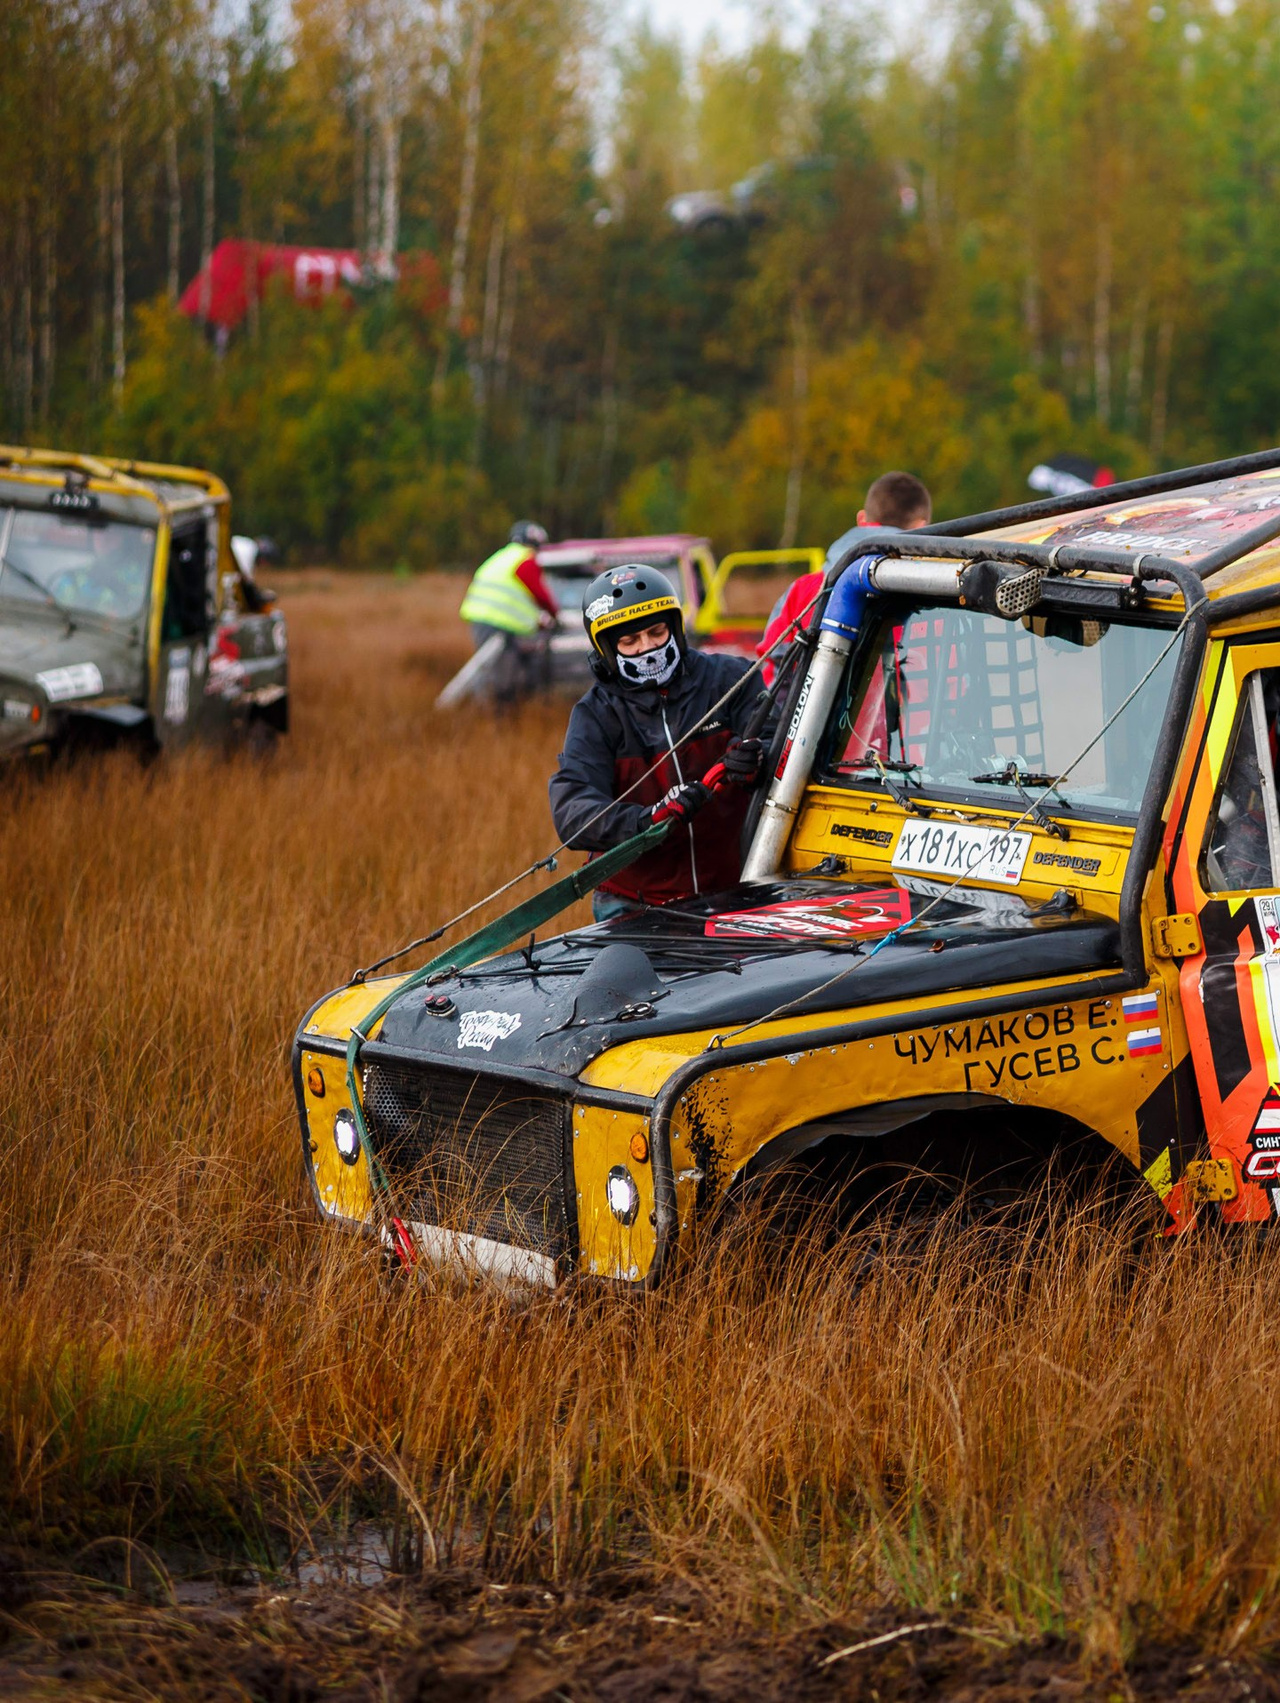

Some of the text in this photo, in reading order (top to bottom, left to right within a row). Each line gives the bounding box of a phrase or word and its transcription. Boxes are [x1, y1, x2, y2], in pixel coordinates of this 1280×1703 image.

[597, 598, 675, 628] BRIDGE RACE TEAM
[830, 823, 894, 844] DEFENDER
[988, 833, 1023, 866] 197
[1033, 851, 1101, 872] DEFENDER
[989, 865, 1006, 877] RUS
[893, 1001, 1118, 1065] ЧУМАКОВ Е.
[963, 1036, 1125, 1091] ГУСЕВ С.
